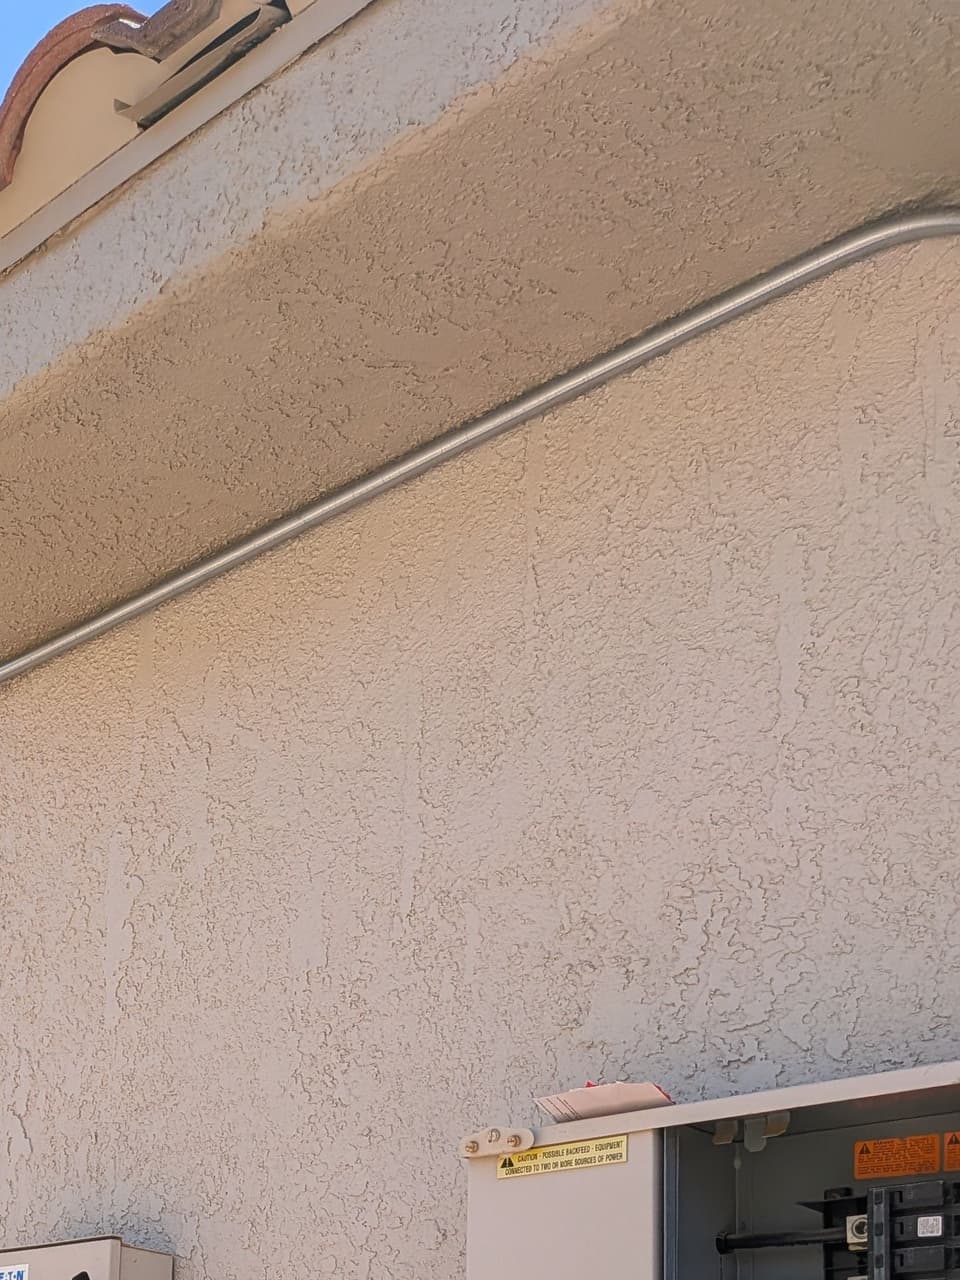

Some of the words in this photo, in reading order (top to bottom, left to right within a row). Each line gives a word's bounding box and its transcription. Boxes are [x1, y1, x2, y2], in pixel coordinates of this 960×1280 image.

[517, 1152, 538, 1163] CAUTION
[542, 1147, 565, 1160] POSSIBLE
[565, 1143, 591, 1157] BACKFEED
[594, 1140, 625, 1152] EQUIPMENT
[504, 1164, 533, 1176] CONNECTED
[533, 1163, 541, 1172] TO
[541, 1161, 552, 1171] TWO
[552, 1160, 559, 1169] OR
[559, 1158, 574, 1169] MORE
[574, 1155, 597, 1167] SOURCES
[597, 1154, 605, 1164] OF
[604, 1152, 624, 1163] POWER
